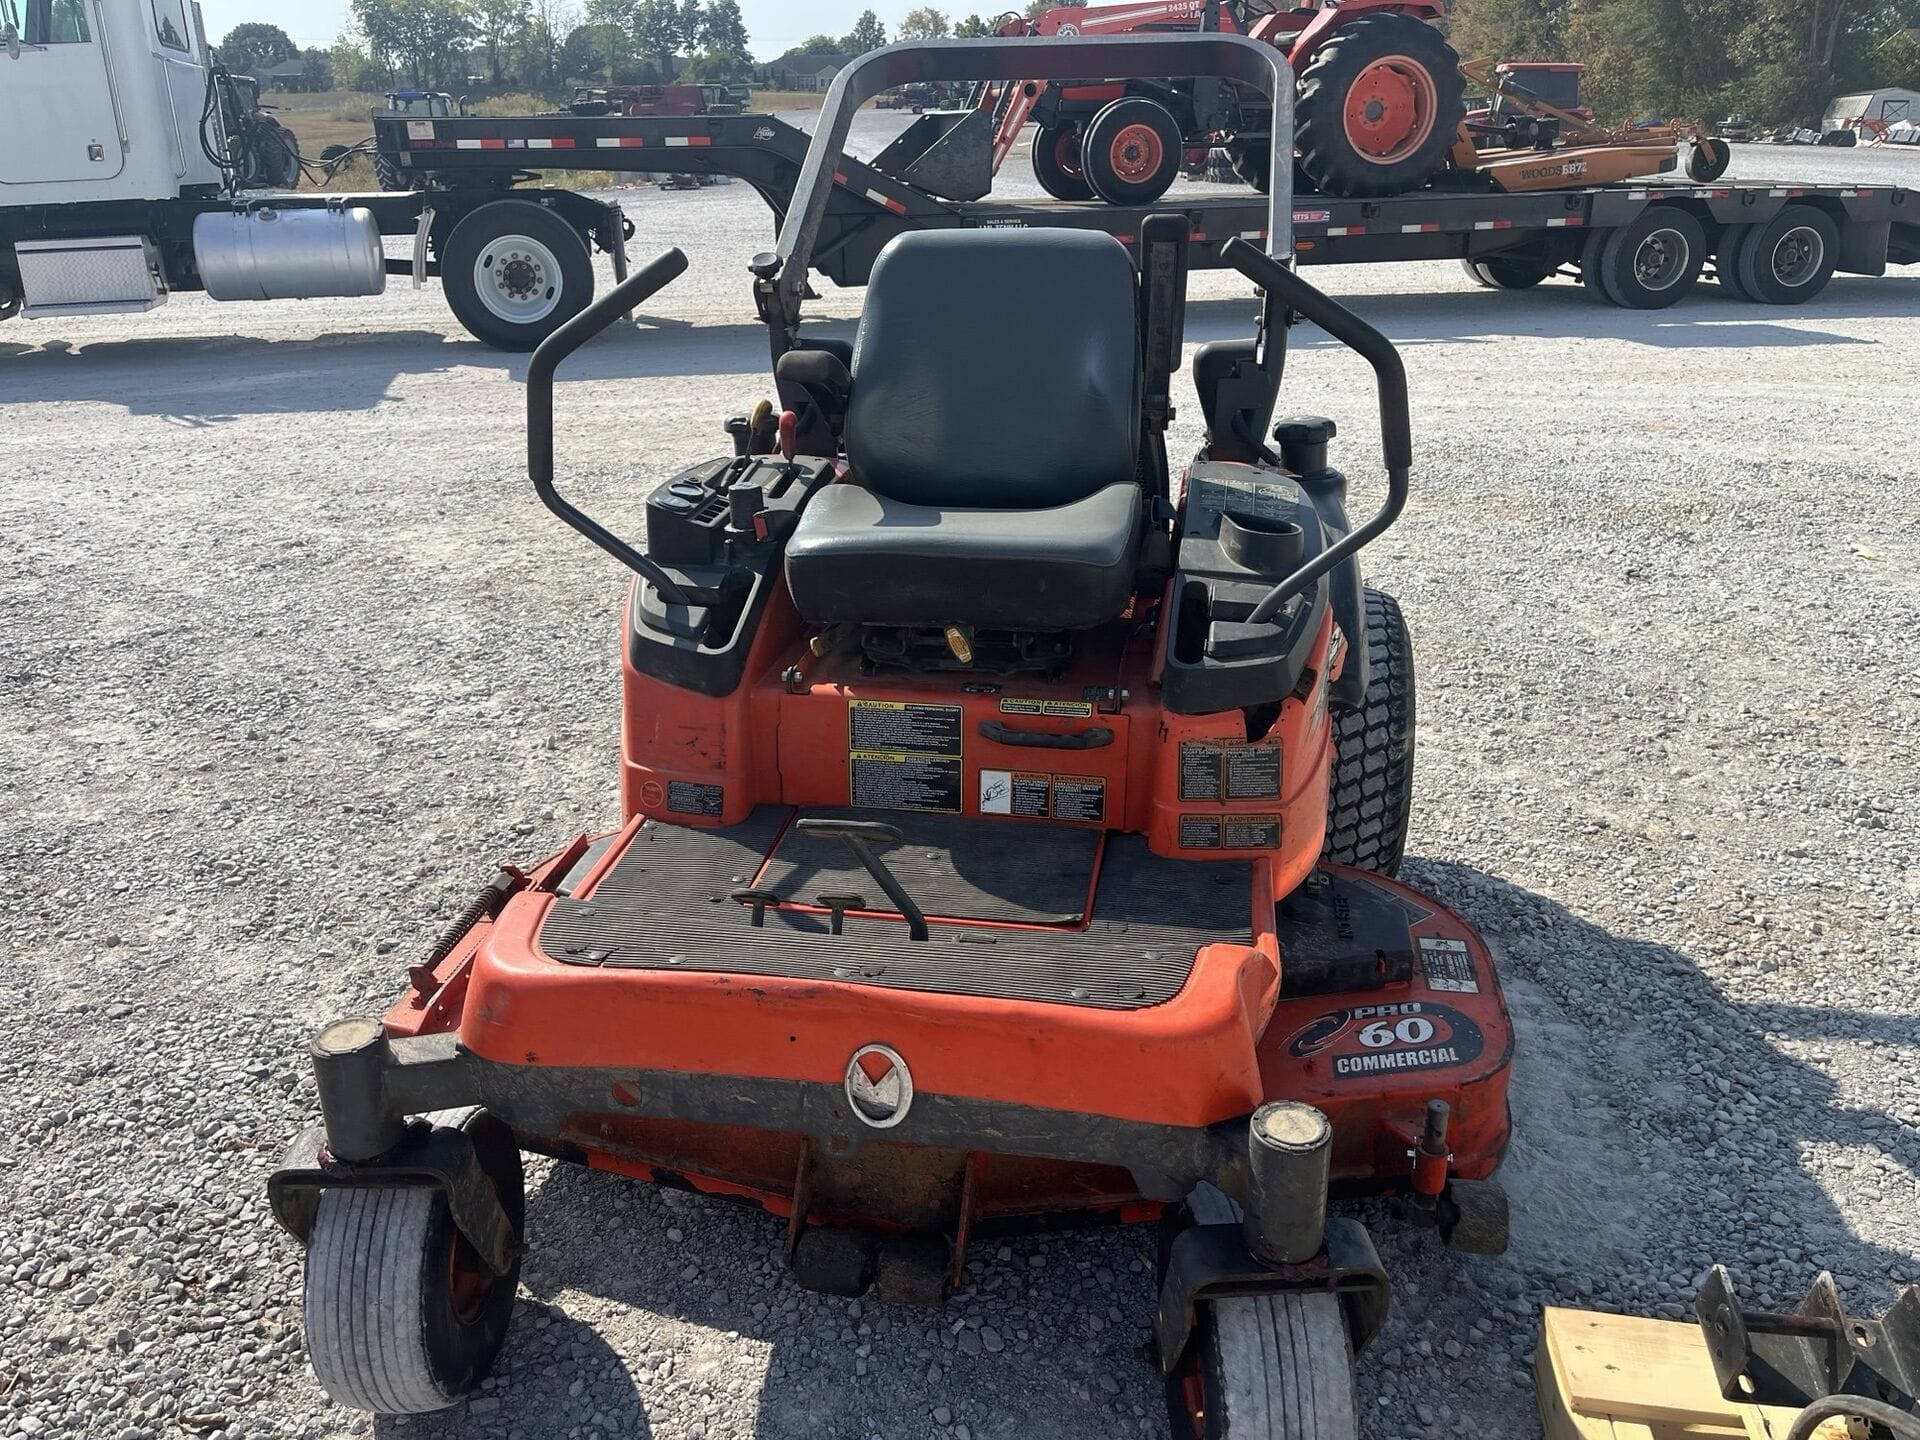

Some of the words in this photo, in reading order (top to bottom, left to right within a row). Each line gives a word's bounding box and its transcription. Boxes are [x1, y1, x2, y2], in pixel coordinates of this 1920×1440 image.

[1168, 3, 1187, 12] 2425
[1189, 1, 1200, 10] QT
[1521, 166, 1562, 179] WOODS
[863, 701, 894, 709] CAUTION
[1355, 1002, 1421, 1019] PRO
[1358, 1018, 1434, 1048] 60
[1336, 1047, 1460, 1073] COMMERCIAL
